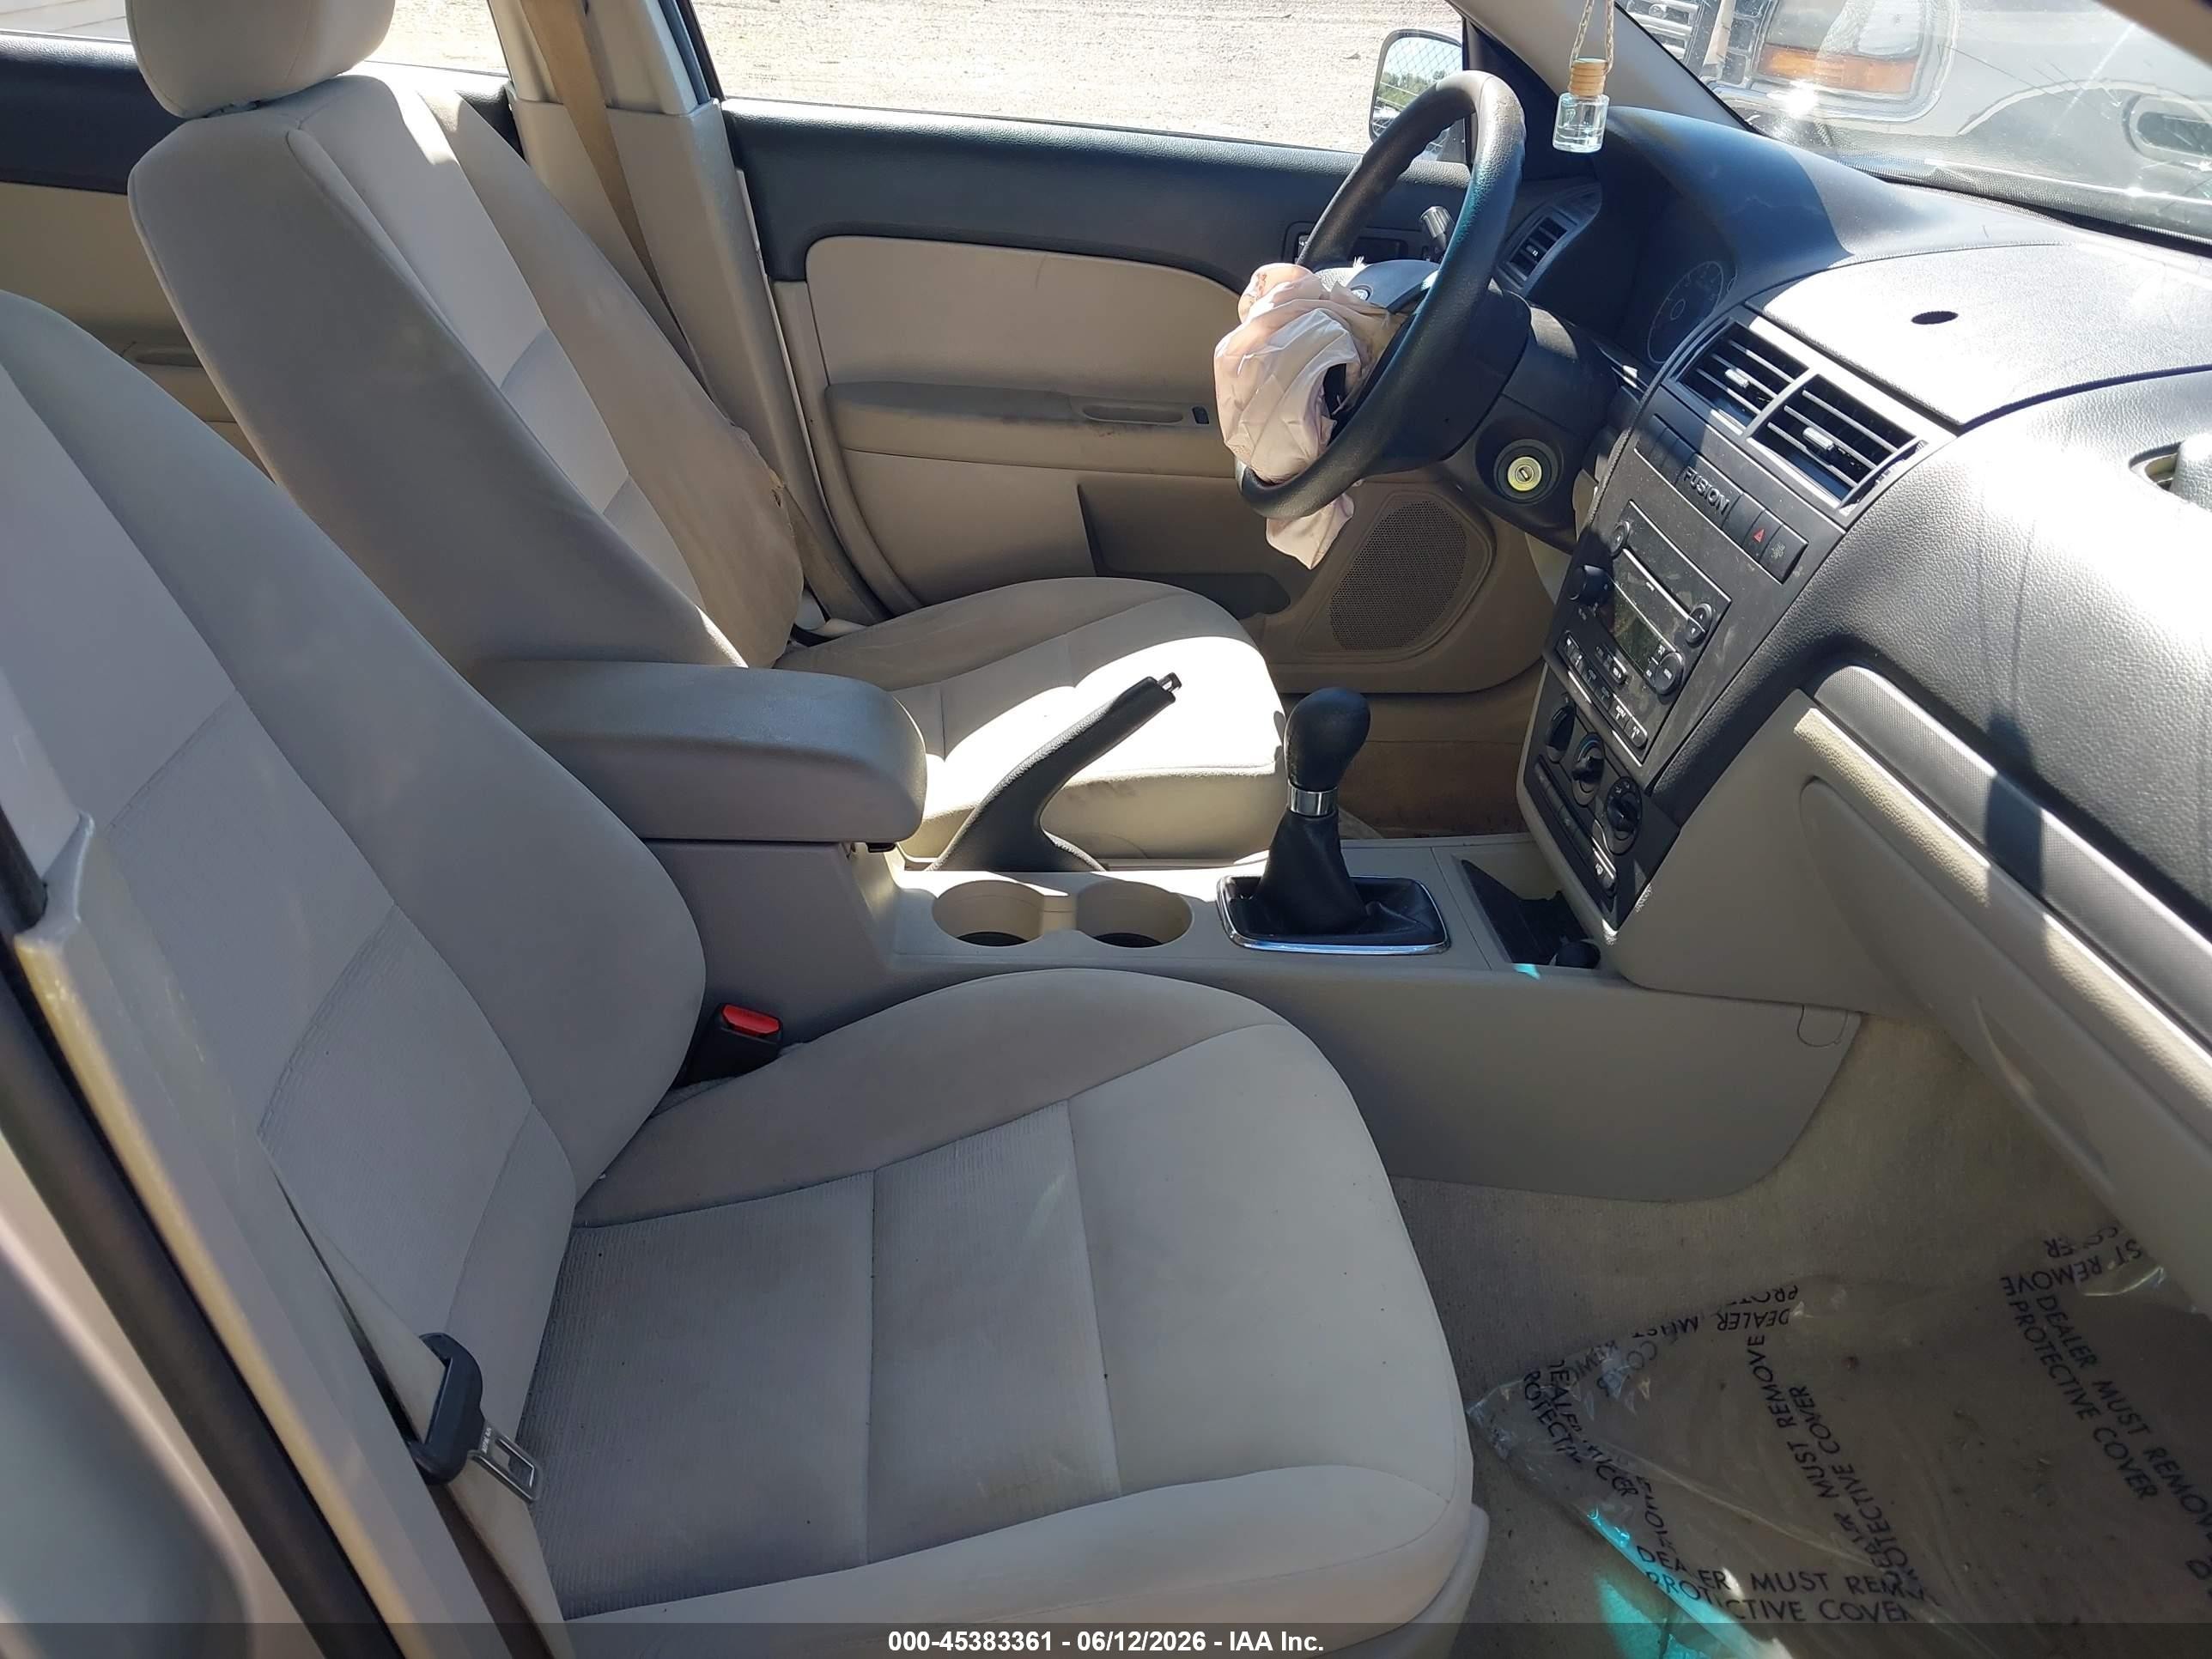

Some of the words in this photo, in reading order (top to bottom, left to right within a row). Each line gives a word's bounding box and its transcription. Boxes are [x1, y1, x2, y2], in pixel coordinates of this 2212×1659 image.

[1684, 466, 1730, 516] FUSION
[2000, 1255, 2103, 1297] REMOVE
[1717, 1308, 1791, 1331] DEALER
[1747, 1335, 1798, 1429] REMOVE
[2035, 1296, 2098, 1369] DEALER
[2093, 1380, 2151, 1436] MUST
[1789, 1385, 1841, 1455] COVER
[2008, 1299, 2101, 1421] PROTECTIVE
[2093, 1426, 2160, 1501] COVER
[1787, 1440, 1839, 1498] MUST
[1637, 1546, 1731, 1590] DEAER
[1751, 1572, 1828, 1593] MUST
[1644, 1571, 1807, 1622] PROTCTIVE
